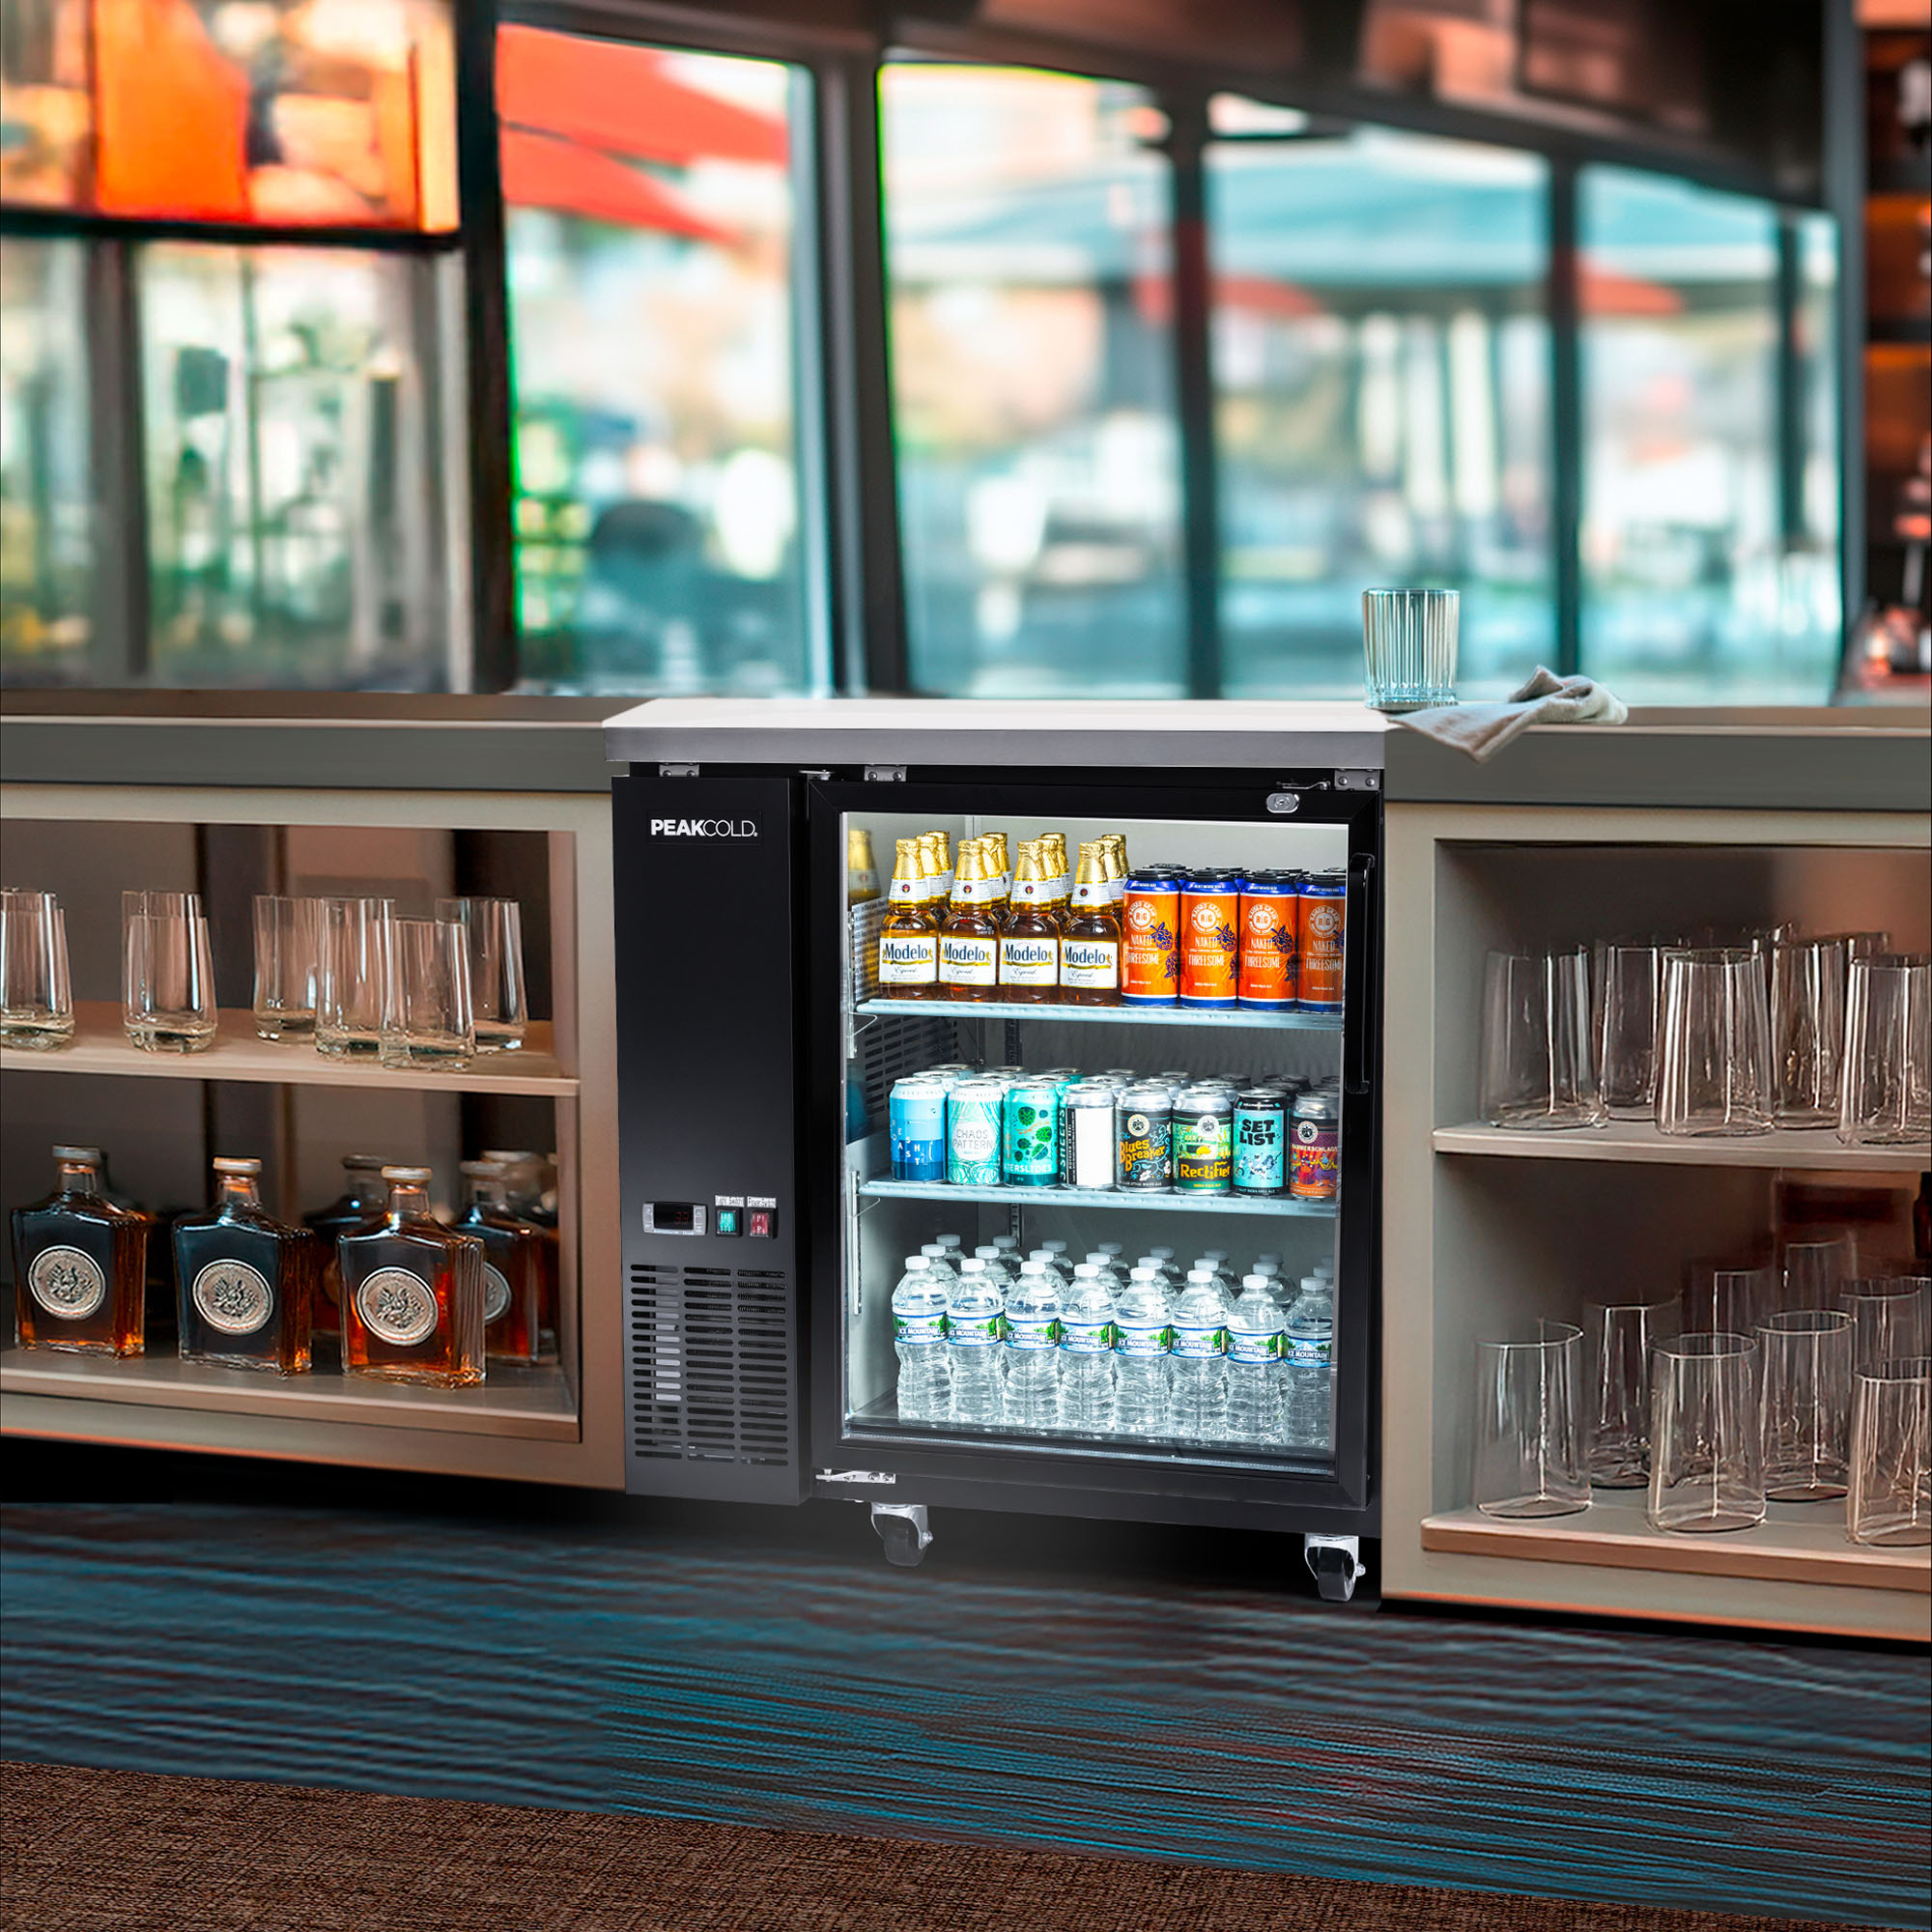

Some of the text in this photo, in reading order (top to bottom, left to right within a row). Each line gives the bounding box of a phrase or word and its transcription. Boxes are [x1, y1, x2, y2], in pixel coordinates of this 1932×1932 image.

[1131, 935, 1151, 946] NAKED
[1195, 937, 1217, 948] NAKED
[1251, 938, 1273, 949] NAKED
[1313, 940, 1335, 951] NAKED
[885, 943, 927, 959] Modelo
[944, 943, 985, 960] Modelo
[1005, 944, 1047, 960] Modelo
[1065, 947, 1105, 964] Modelo
[1242, 1119, 1275, 1132] SET
[956, 1128, 988, 1140] CHAOS
[1239, 1130, 1275, 1146] LIST
[952, 1138, 993, 1150] PATTERN
[1119, 1139, 1150, 1163] Blues
[1124, 1146, 1165, 1172] Breaker
[1180, 1161, 1231, 1179] Rectifier
